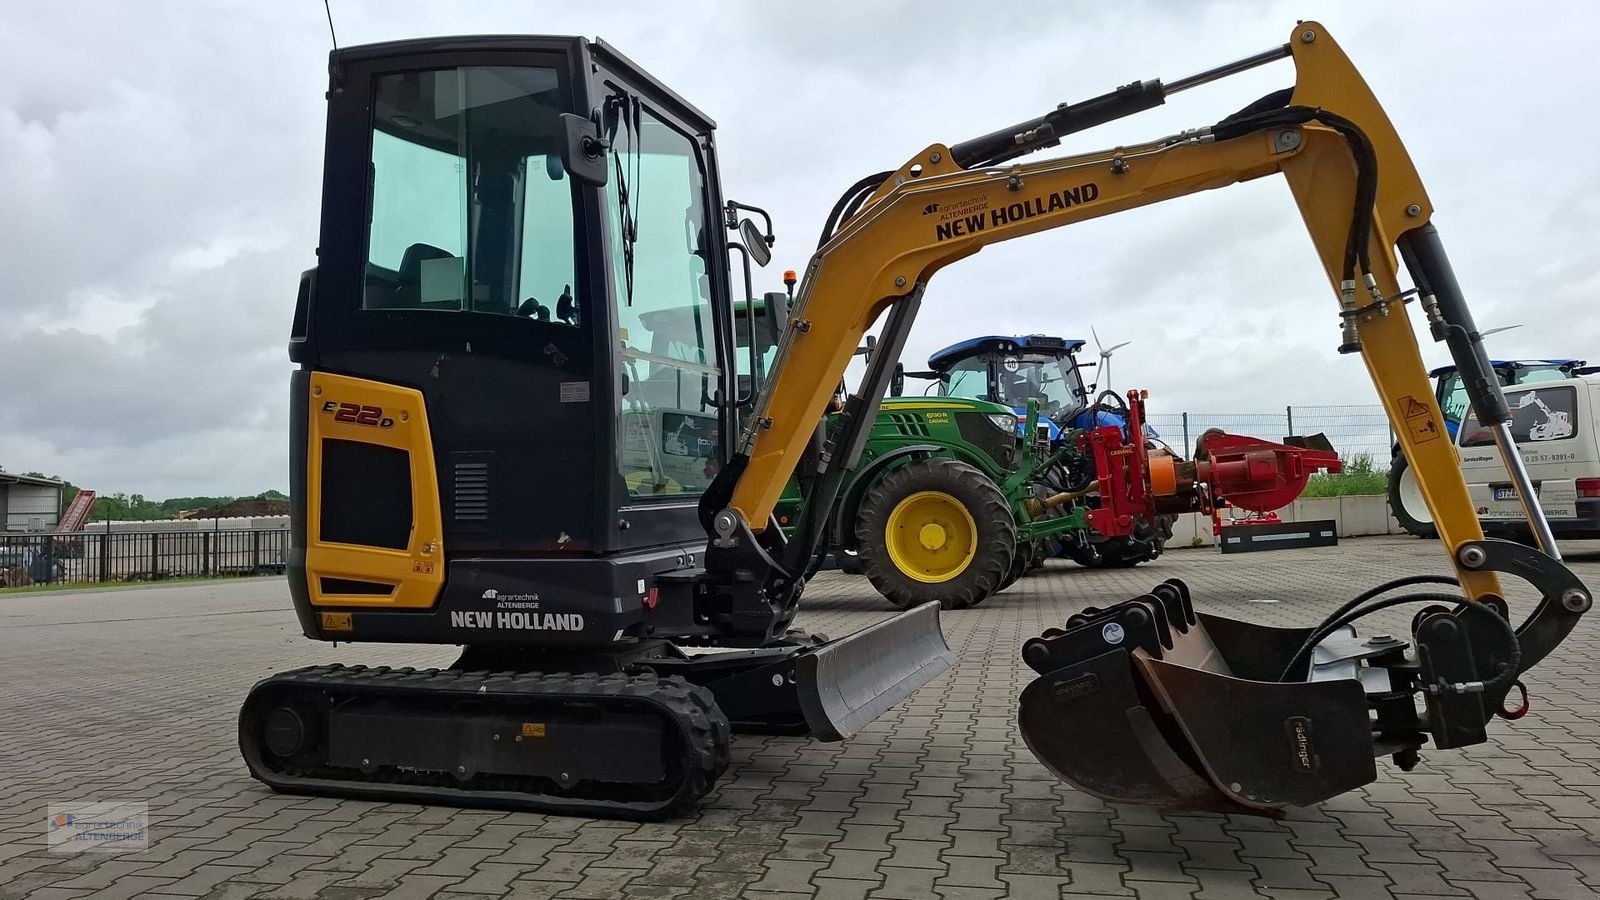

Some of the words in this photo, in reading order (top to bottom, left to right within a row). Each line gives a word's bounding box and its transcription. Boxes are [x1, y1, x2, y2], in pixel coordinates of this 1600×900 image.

[936, 213, 985, 241] NEW
[991, 182, 1099, 227] HOLLAND
[939, 193, 988, 213] agrartechnik
[940, 202, 989, 221] ALTENBERGE
[497, 593, 539, 602] agrartechnik
[451, 610, 493, 628] NEW
[496, 612, 585, 631] HOLLAND
